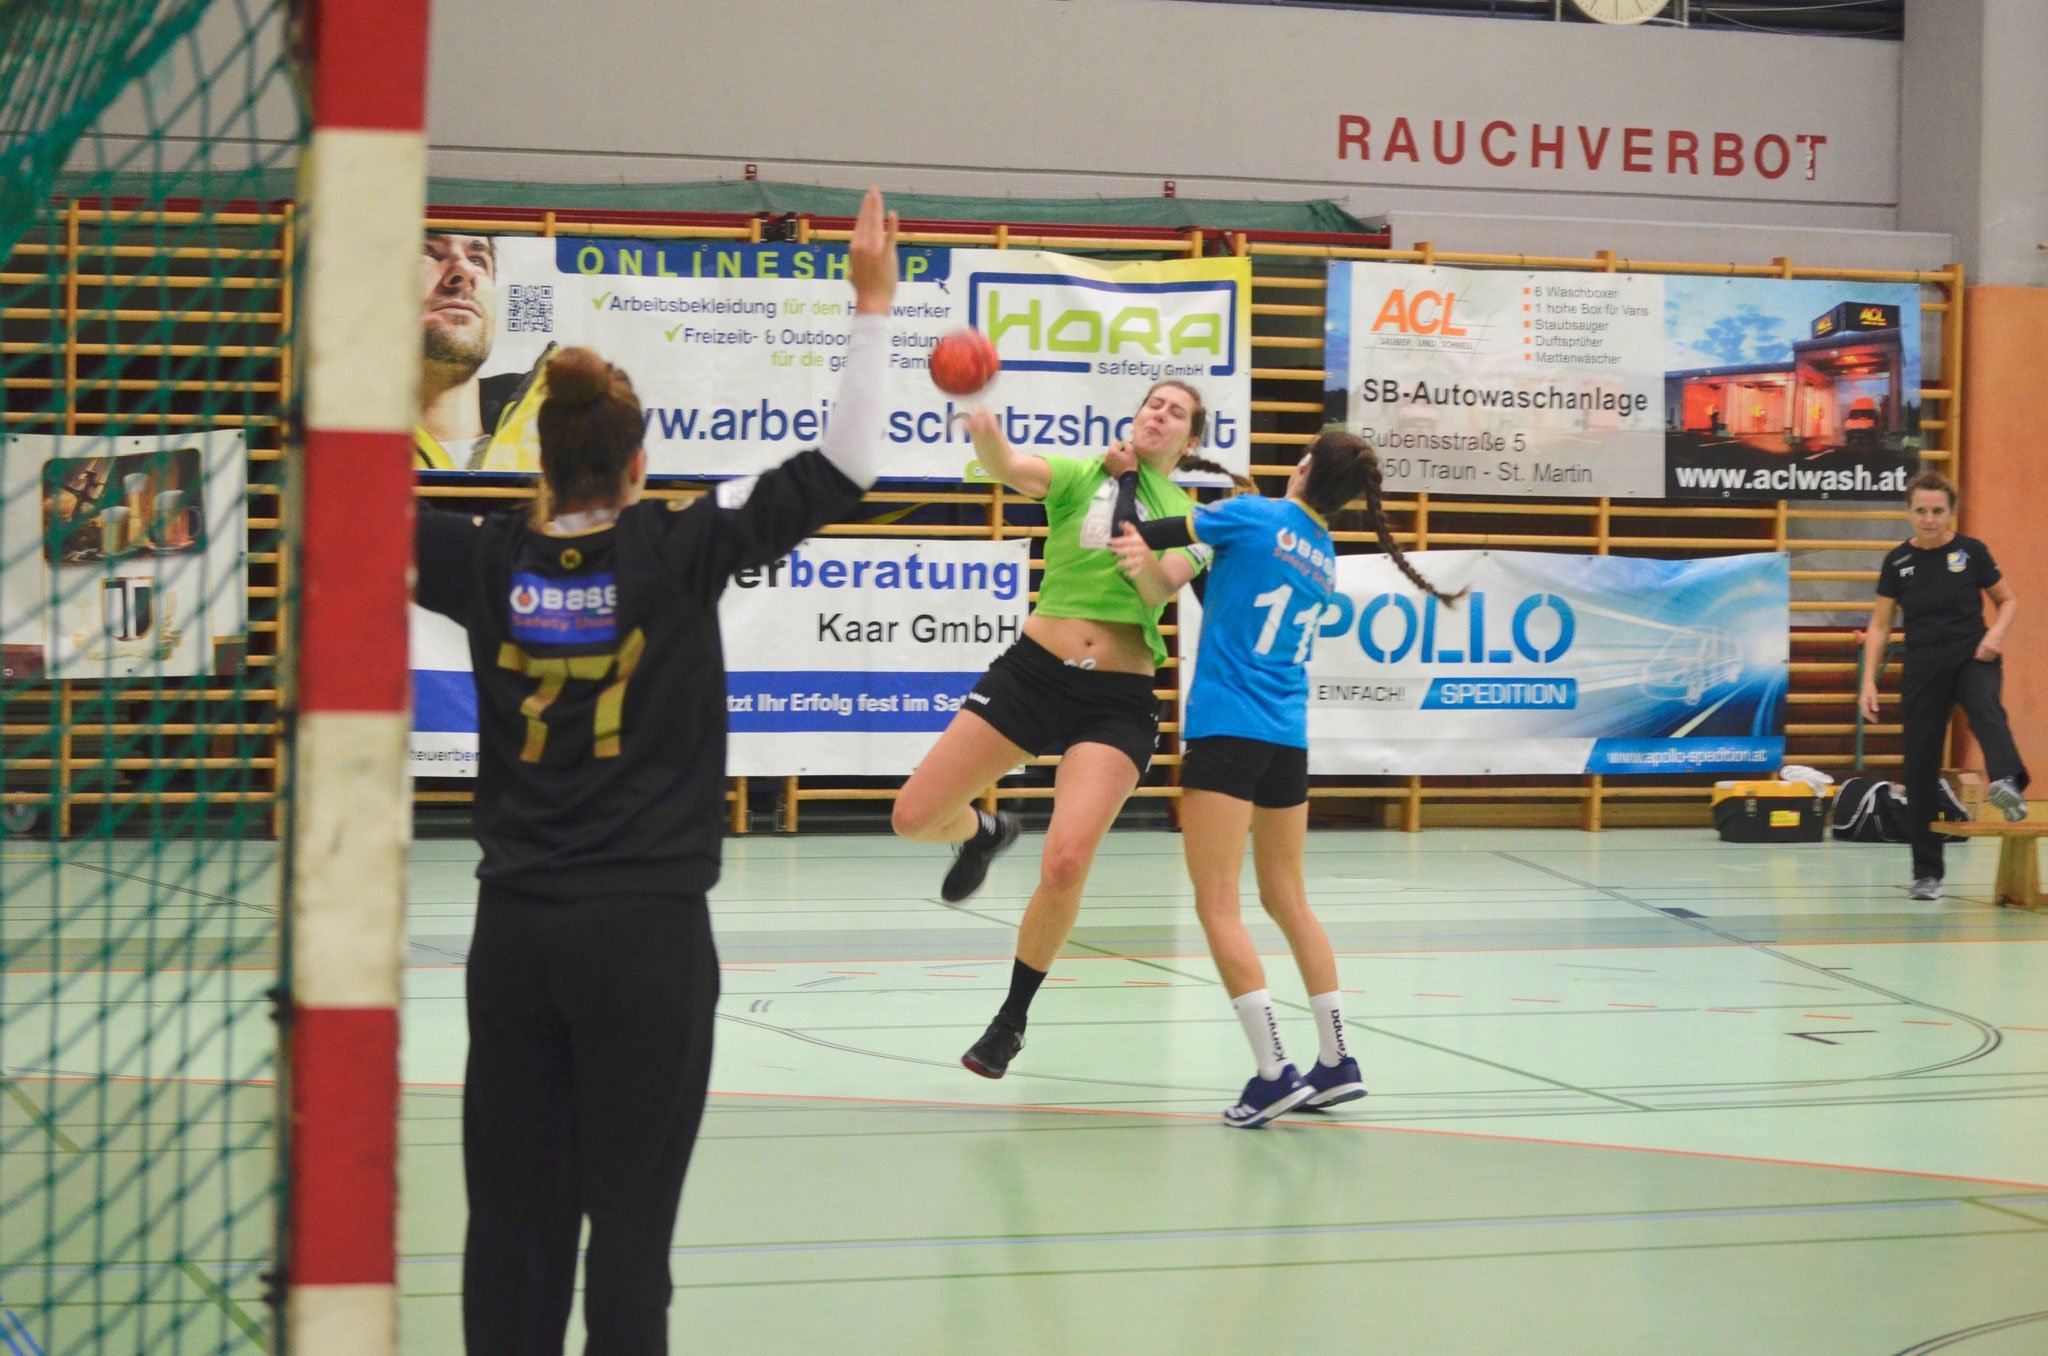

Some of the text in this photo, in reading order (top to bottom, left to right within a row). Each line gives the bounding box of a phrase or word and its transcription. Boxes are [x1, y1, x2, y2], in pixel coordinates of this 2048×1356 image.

[1338, 113, 1828, 181] RAUCHVERBOT
[577, 246, 928, 282] ONLINESHP
[1535, 286, 1618, 299] 6 Waschboxen
[609, 296, 951, 318] Arbeitsbekleidung für den Hwerker
[1371, 289, 1468, 336] ACL
[1535, 302, 1649, 317] 1 hohe Box für Vans
[988, 289, 1222, 356] HORA
[1535, 319, 1610, 333] Staubsauger
[683, 327, 759, 344] Freizeit-
[766, 329, 775, 344] &
[1417, 339, 1437, 348] UND
[1535, 335, 1603, 349] Duftsprüher
[771, 350, 795, 367] für
[802, 351, 825, 367] die
[1536, 352, 1621, 365] Mattenwäscher
[1099, 361, 1204, 381] safety GmbH
[1362, 378, 1648, 417] SB-Autowaschanlage
[1361, 427, 1526, 452] Rubensstraße 5
[1418, 459, 1476, 480] Traun
[1498, 461, 1525, 482] St.
[1532, 463, 1593, 483] Martin
[1675, 463, 1907, 491] www.aclwash.at
[726, 550, 1019, 601] erberatung
[817, 612, 1019, 643] Kaar GmbH
[1253, 583, 1322, 664] 11
[1306, 591, 1577, 664] POLLO
[496, 627, 647, 764] 77
[757, 693, 789, 712] Ihr
[791, 693, 852, 716] Erfolg
[857, 693, 899, 712] fest
[902, 693, 929, 712] im
[1318, 684, 1405, 702] EINFACH!
[1440, 683, 1567, 704] SPEDITION
[1606, 747, 1768, 767] www.apollo-spedition.at
